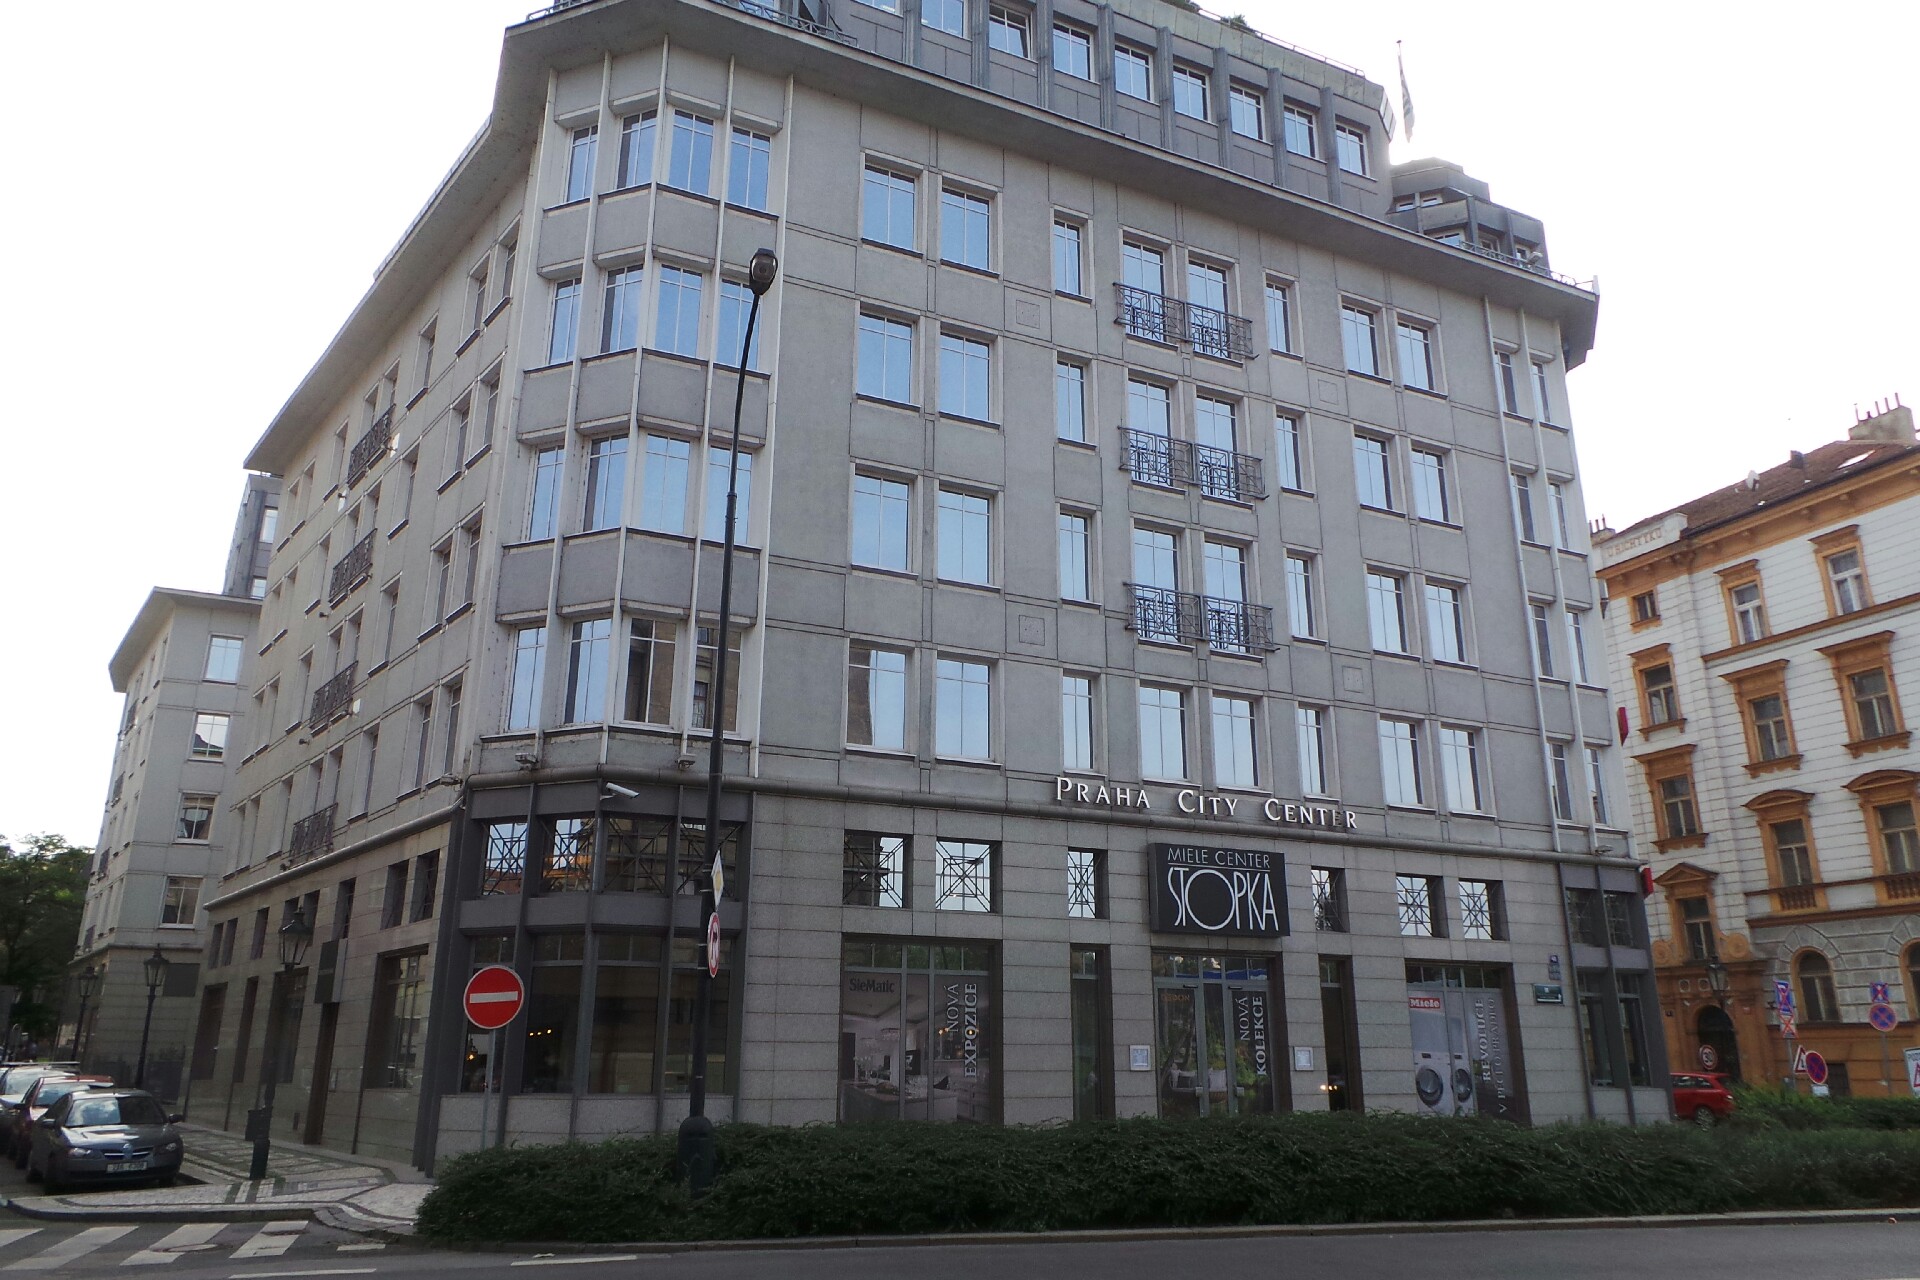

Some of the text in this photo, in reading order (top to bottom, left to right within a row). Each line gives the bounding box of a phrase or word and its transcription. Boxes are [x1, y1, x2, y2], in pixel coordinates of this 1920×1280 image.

[1056, 776, 1358, 829] PRAHA CITY CENTER
[1167, 847, 1271, 869] MIELE CENTER
[1167, 866, 1280, 932] STOPKA
[849, 978, 896, 993] SieMatic
[943, 983, 959, 1032] NOVÁ
[1409, 998, 1440, 1008] Miele
[964, 983, 977, 1078] EXPOZICE
[1235, 996, 1250, 1041] NOVÁ
[1252, 996, 1267, 1076] KOLEKCE
[1475, 1000, 1491, 1081] REVOLUCE
